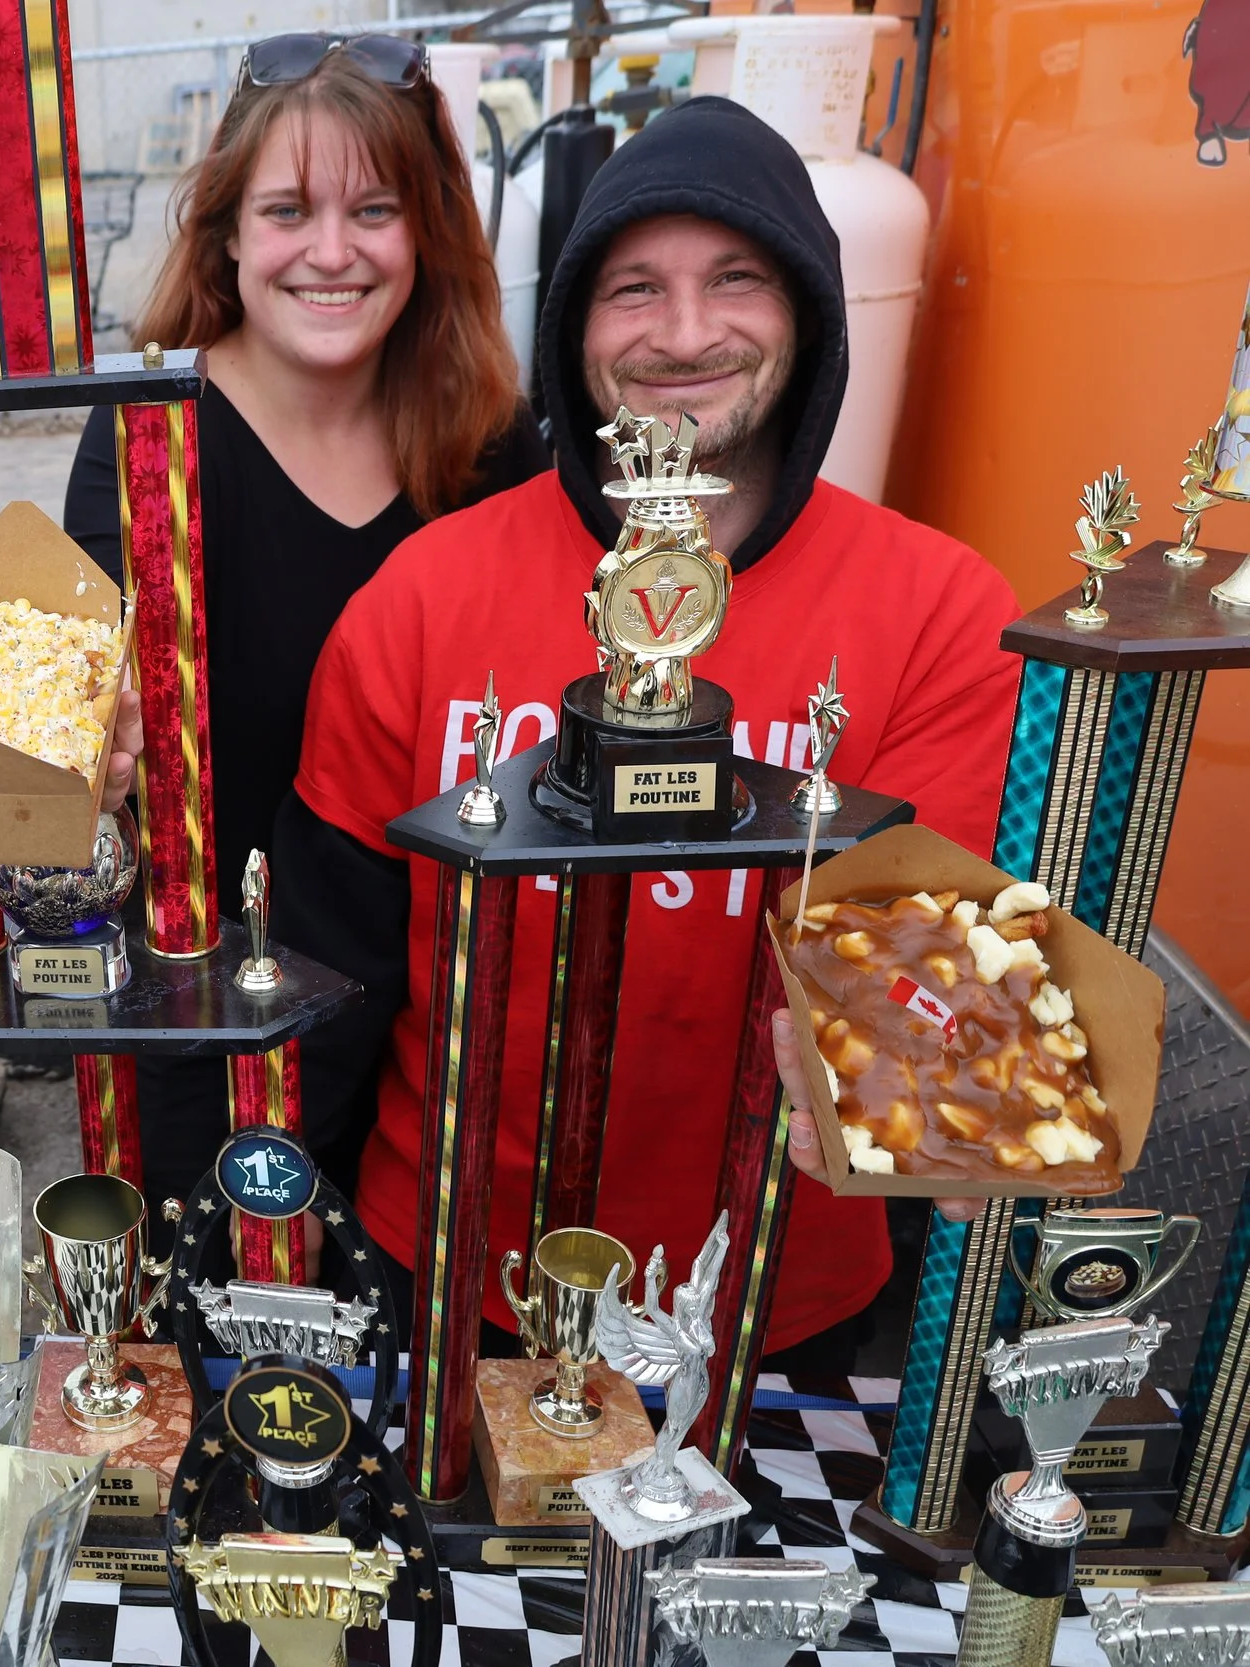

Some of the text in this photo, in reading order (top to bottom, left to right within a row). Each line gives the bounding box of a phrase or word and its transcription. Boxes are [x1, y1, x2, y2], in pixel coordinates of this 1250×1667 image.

[634, 771, 697, 785] FAT LES
[629, 790, 701, 805] POUTINE
[35, 959, 88, 969] FAT LES
[33, 973, 92, 984] POUTINE
[246, 1186, 290, 1199] PLACE
[262, 1427, 318, 1443] PLACE
[1073, 1446, 1127, 1457] FAT LES
[1067, 1458, 1129, 1469] POUTINE
[93, 1495, 140, 1507] TINE
[552, 1492, 575, 1500] FAT
[547, 1503, 590, 1511] POUTI
[1091, 1515, 1117, 1524] LES
[1087, 1527, 1118, 1535] TINE
[107, 1551, 159, 1561] POUTINE
[73, 1561, 112, 1570] UTINE
[115, 1563, 128, 1571] IN
[1095, 1568, 1110, 1576] IN
[1112, 1568, 1162, 1577] LONDON
[1073, 1578, 1096, 1586] 025
[196, 1574, 386, 1631] WINNER
